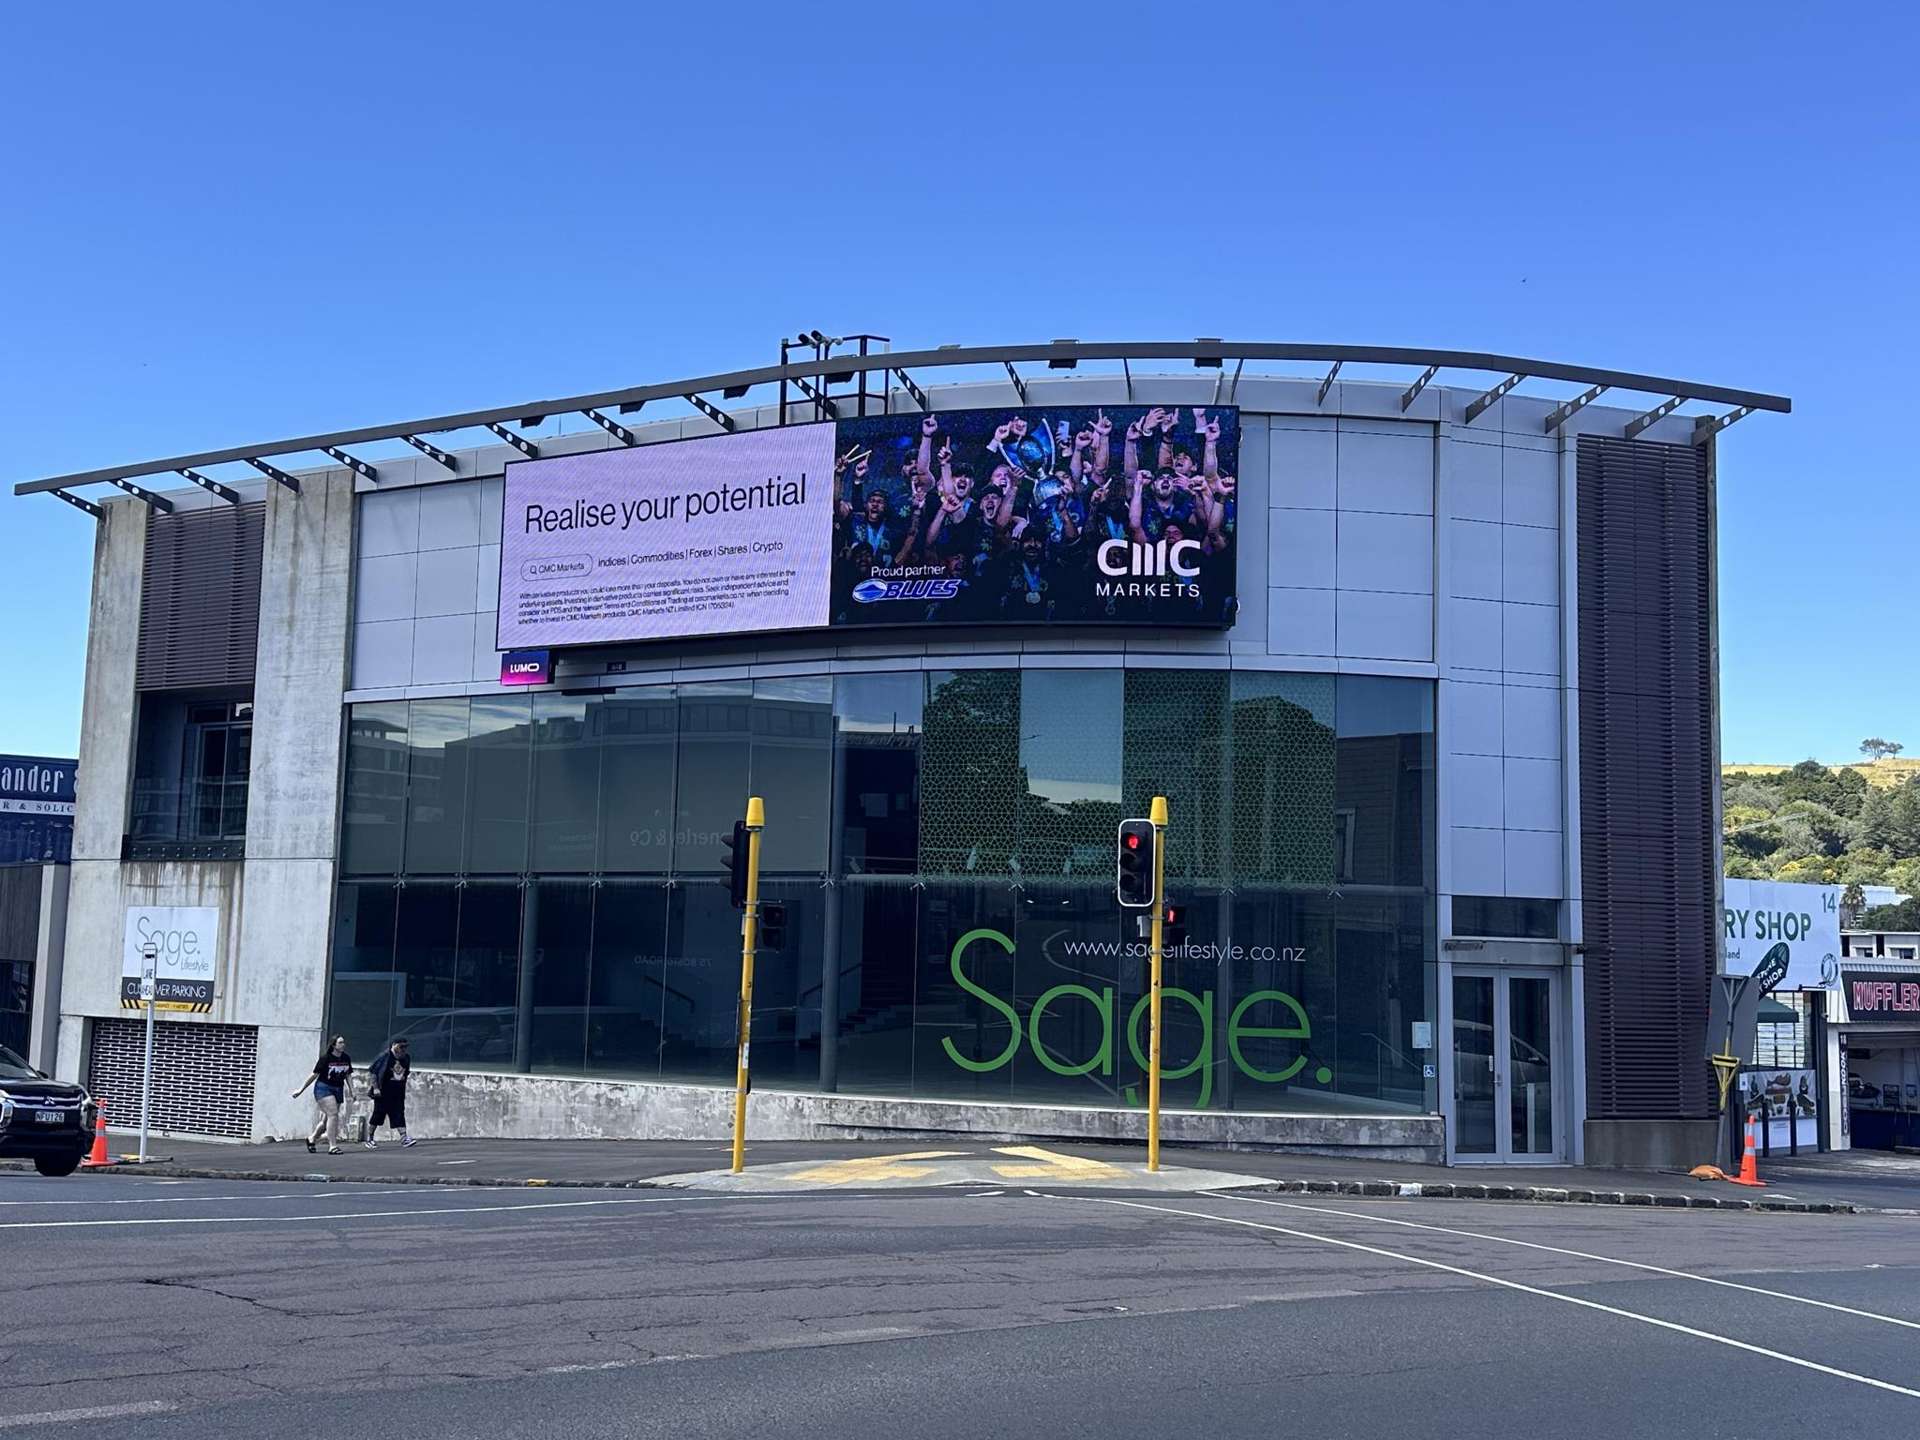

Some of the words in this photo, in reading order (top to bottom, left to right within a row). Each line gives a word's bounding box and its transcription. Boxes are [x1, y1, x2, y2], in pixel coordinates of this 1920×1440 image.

[525, 499, 616, 534] Realise
[621, 494, 680, 530] your
[685, 473, 806, 523] potential
[598, 557, 626, 567] Indices
[630, 550, 685, 565] Commodities
[689, 548, 713, 559] Forex
[717, 545, 748, 556] Shares
[752, 541, 784, 553] Crypto
[1097, 538, 1201, 577] CMC
[539, 564, 556, 574] CMC
[556, 562, 585, 572] Markets
[871, 565, 904, 577] Proud
[905, 564, 946, 578] partner
[881, 579, 962, 600] BLUES
[1096, 583, 1200, 597] MARKETS
[510, 663, 540, 673] LUMO
[1, 765, 64, 794] ander
[3, 801, 10, 809] R
[36, 803, 73, 812] SOLIC
[1821, 892, 1837, 913] 14
[1725, 908, 1750, 939] RY
[1755, 909, 1812, 942] SHOP
[135, 916, 201, 966] Sage.
[1762, 968, 1783, 989] SHOP
[127, 982, 170, 997] CUMER
[171, 984, 207, 998] PARKING
[1853, 981, 1920, 1011] MUFFLER
[942, 928, 1334, 1108] Sage.
